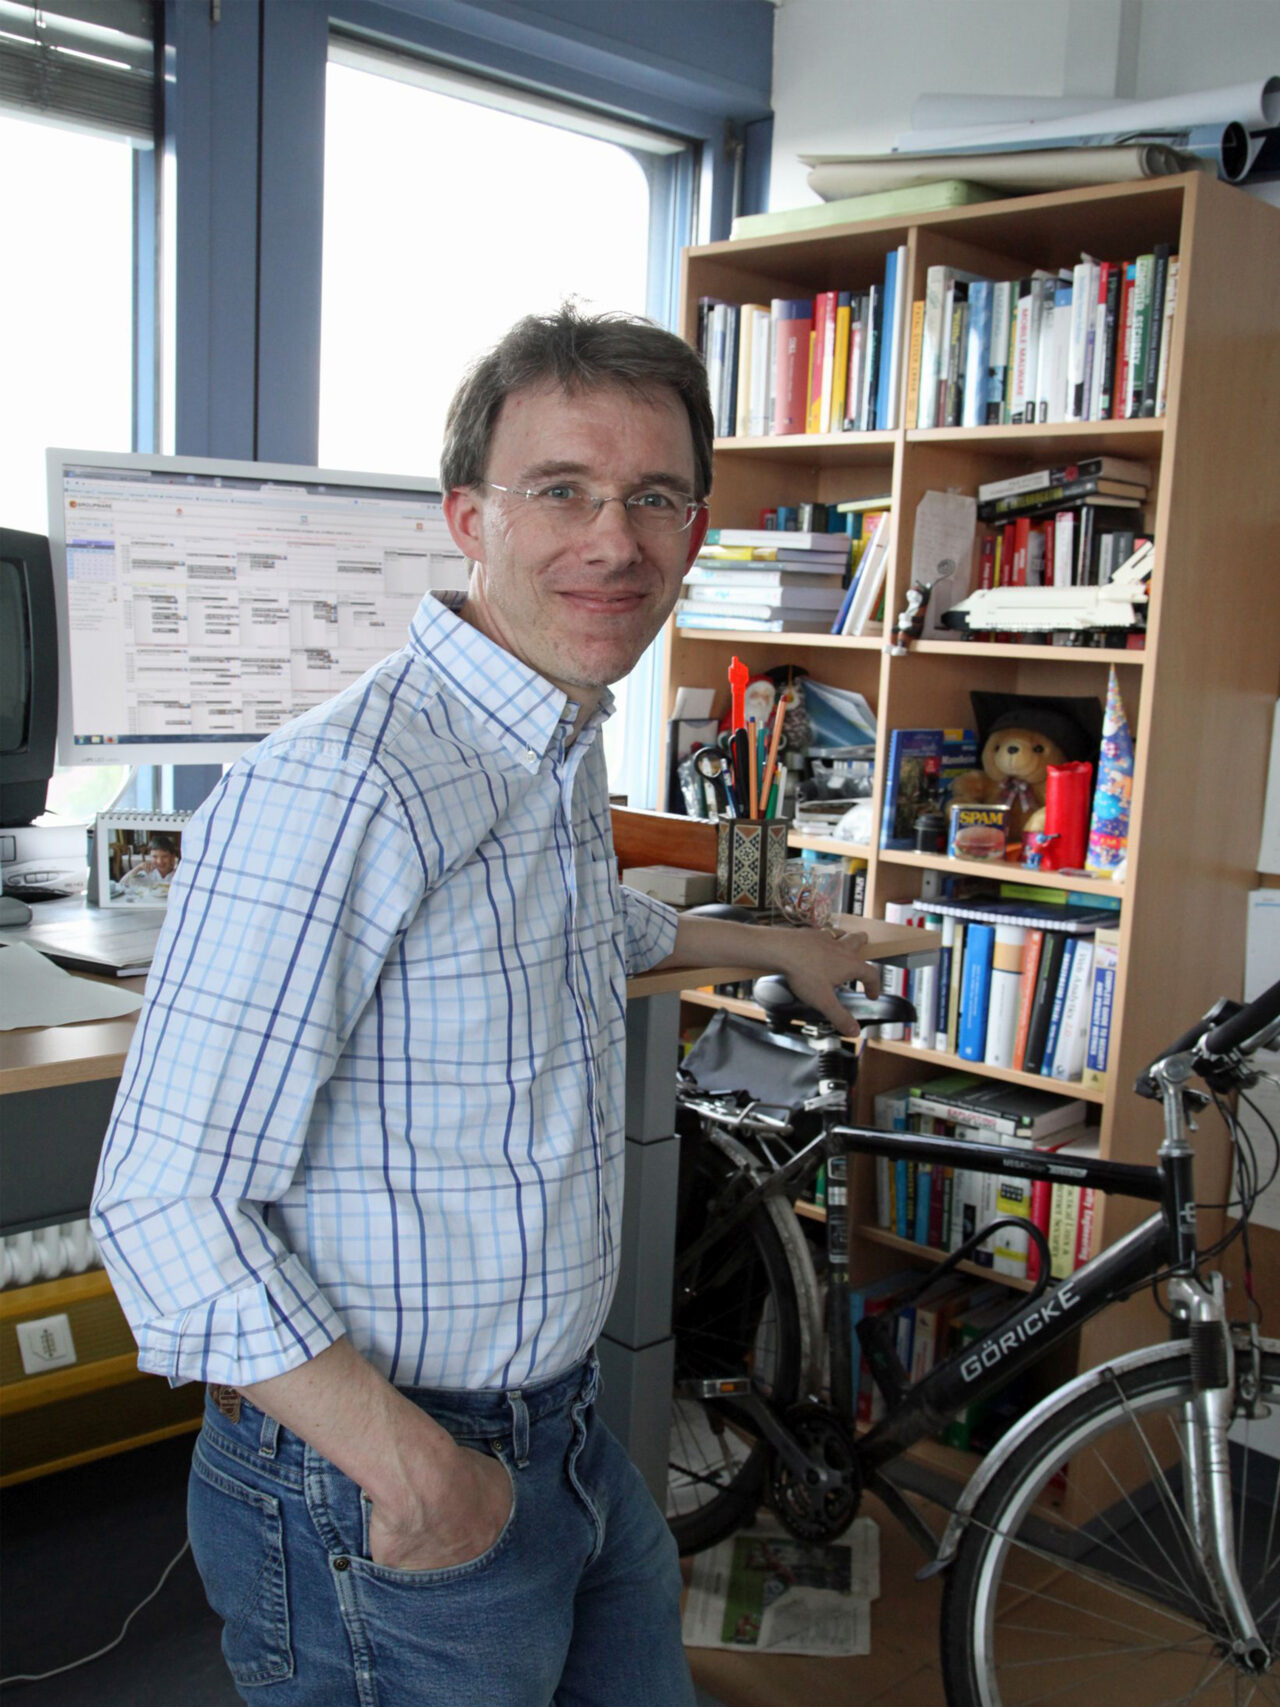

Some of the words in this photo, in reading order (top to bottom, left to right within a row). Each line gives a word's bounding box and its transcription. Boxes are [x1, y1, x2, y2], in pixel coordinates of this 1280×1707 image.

[1019, 308, 1029, 344] MOBILE
[1132, 316, 1143, 365] SECURITY
[1016, 348, 1027, 396] MALWARE
[959, 810, 1004, 825] SPAM
[854, 877, 865, 900] SPACE
[1075, 953, 1087, 972] Web
[1067, 975, 1082, 1020] Analytics
[1102, 971, 1113, 1005] COMPLETE
[1093, 997, 1102, 1025] PRIVACY
[1101, 1007, 1109, 1026] GUIDE
[1100, 1028, 1107, 1037] TO
[1096, 1038, 1106, 1070] SECURITY
[1065, 1184, 1076, 1221] ractical
[1078, 1209, 1093, 1260] Engineering
[960, 1281, 1081, 1383] GÖRICKE
